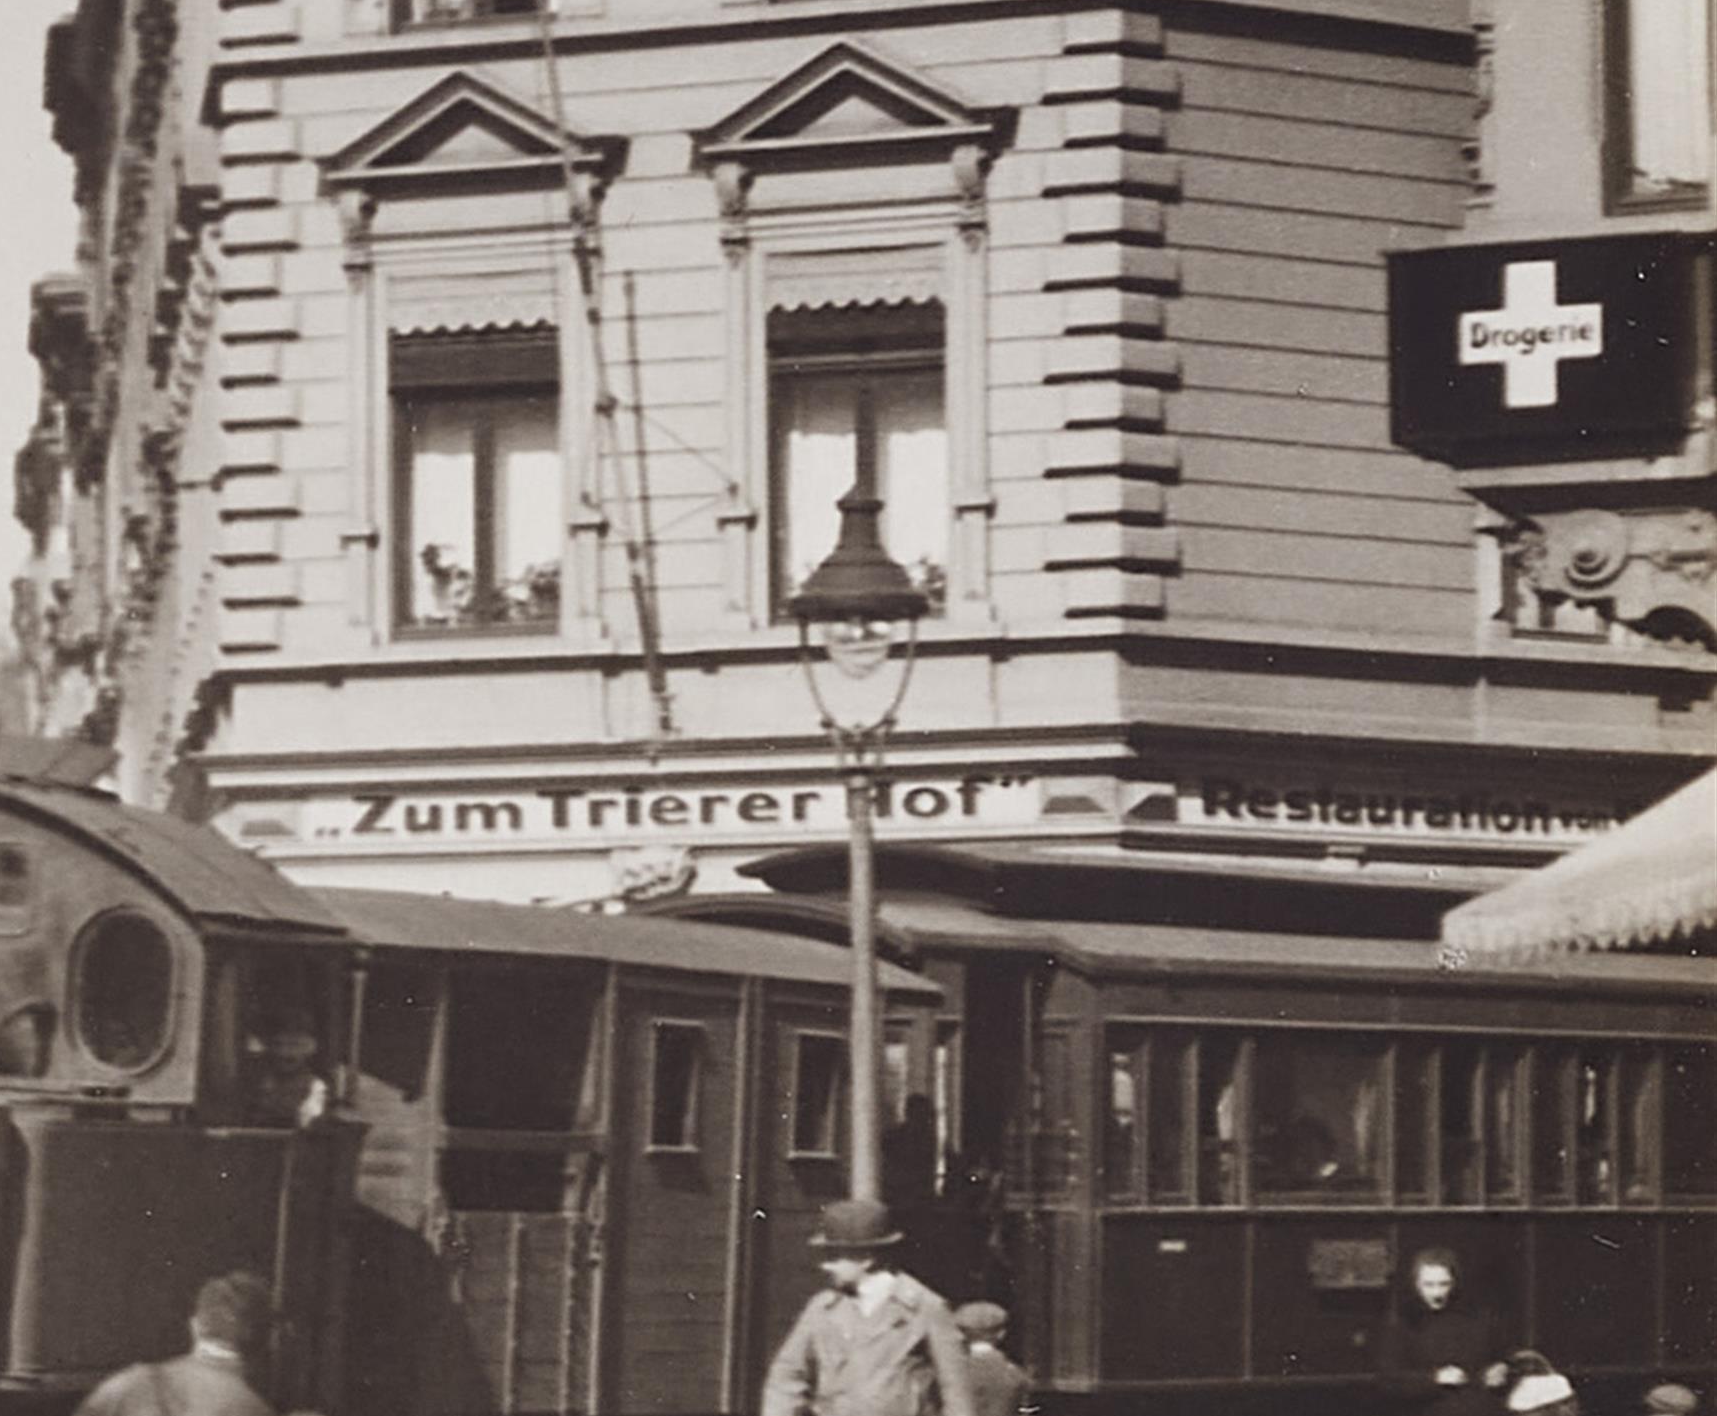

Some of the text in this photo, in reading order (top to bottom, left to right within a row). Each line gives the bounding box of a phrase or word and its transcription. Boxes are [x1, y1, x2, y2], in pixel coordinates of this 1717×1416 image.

[1470, 318, 1593, 356] Drogerie
[535, 785, 821, 829] Trierer
[1201, 779, 1550, 836] Restauration
